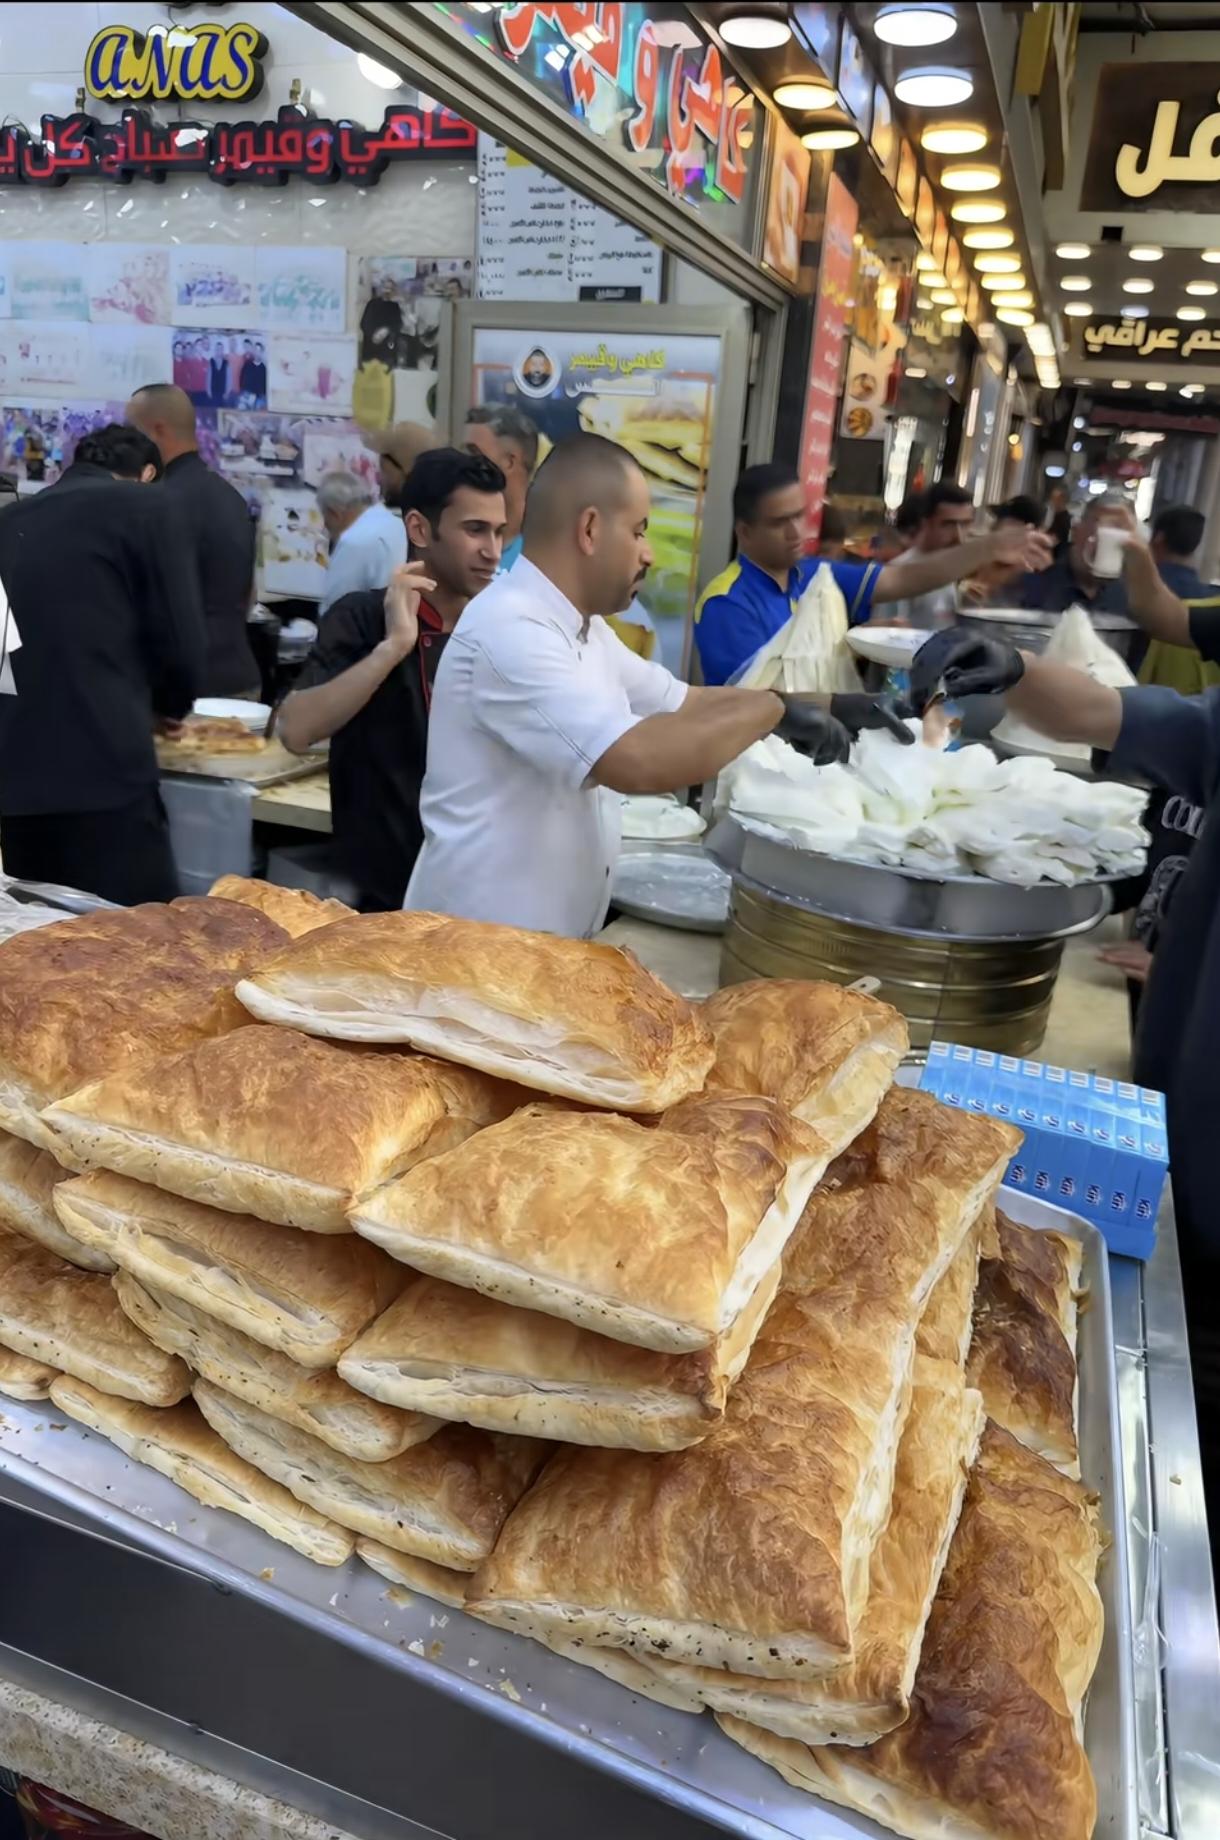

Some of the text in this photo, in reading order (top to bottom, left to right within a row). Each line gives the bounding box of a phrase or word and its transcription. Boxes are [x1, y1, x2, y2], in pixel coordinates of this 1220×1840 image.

[24, 119, 91, 178] كل
[101, 115, 206, 175] صباح
[341, 111, 477, 175] كاهي
[1084, 319, 1180, 356] عراقي
